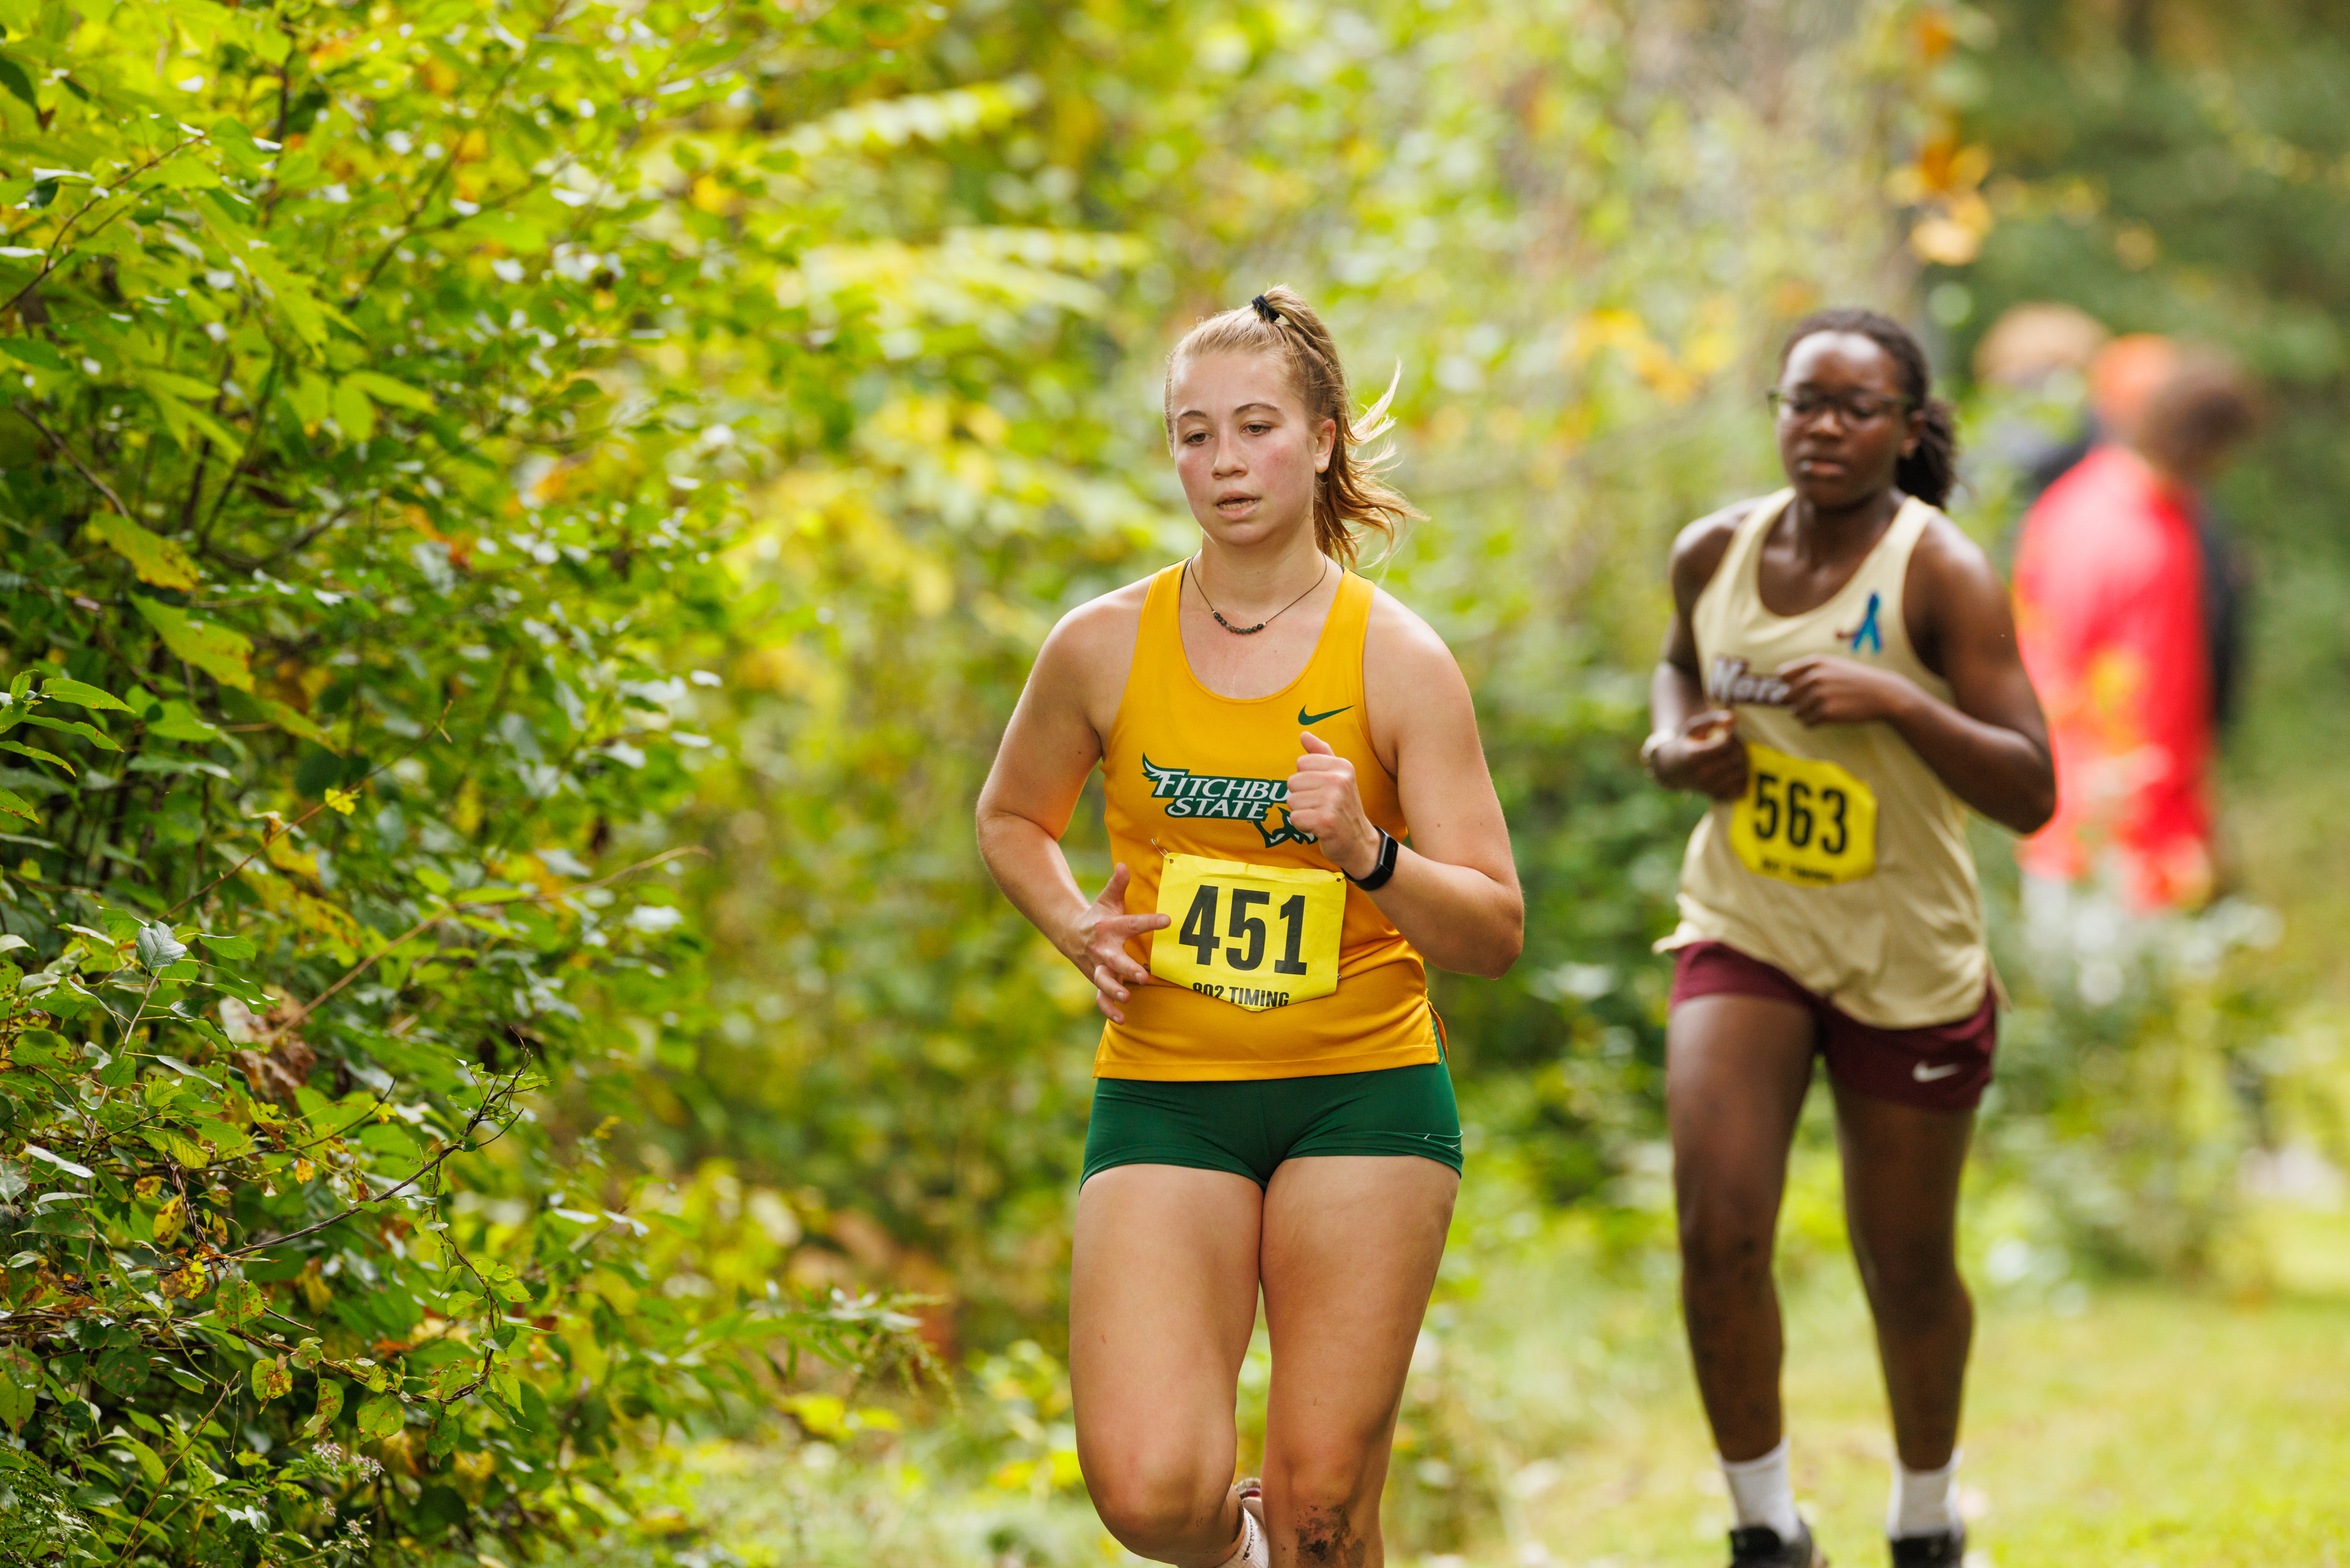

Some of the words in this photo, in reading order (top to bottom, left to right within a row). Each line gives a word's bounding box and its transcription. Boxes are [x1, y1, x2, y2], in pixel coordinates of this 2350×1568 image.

[1143, 759, 1290, 801] FITCHBU
[1167, 796, 1271, 819] STATE
[1754, 773, 1847, 855] 563
[1179, 885, 1307, 976] 451
[1229, 986, 1290, 1008] TIMING
